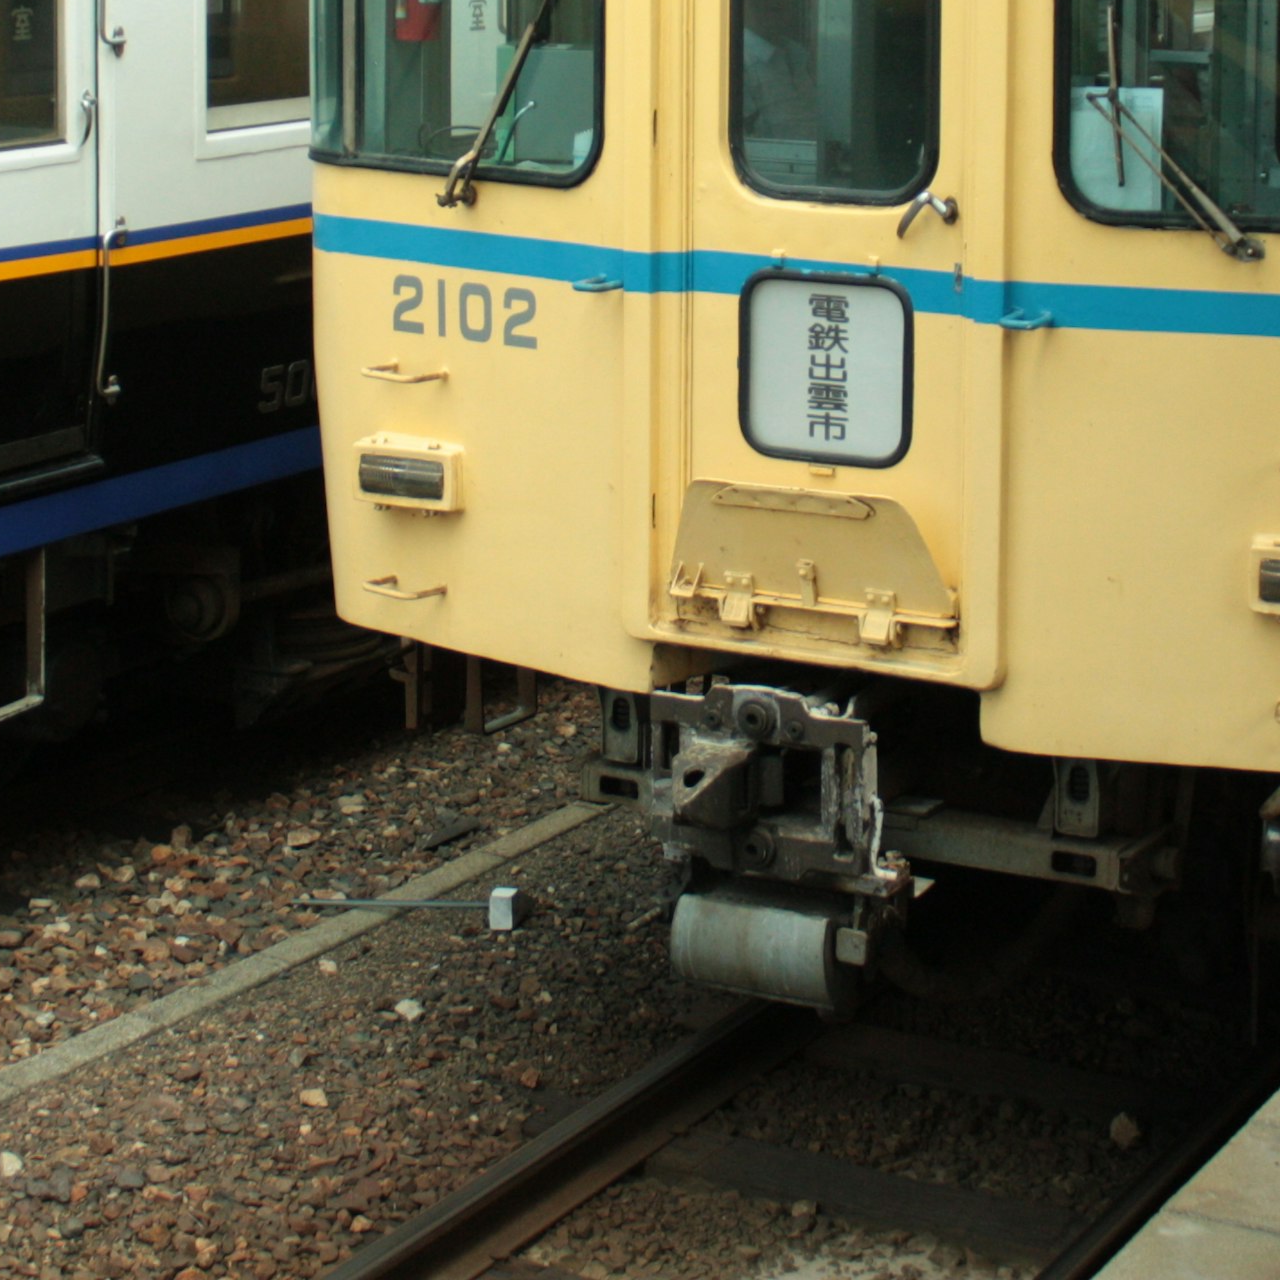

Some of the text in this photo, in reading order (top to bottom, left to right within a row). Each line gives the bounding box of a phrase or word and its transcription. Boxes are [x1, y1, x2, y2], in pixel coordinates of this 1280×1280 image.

[392, 273, 538, 350] 2102
[806, 293, 849, 441] 電鉄出雲市
